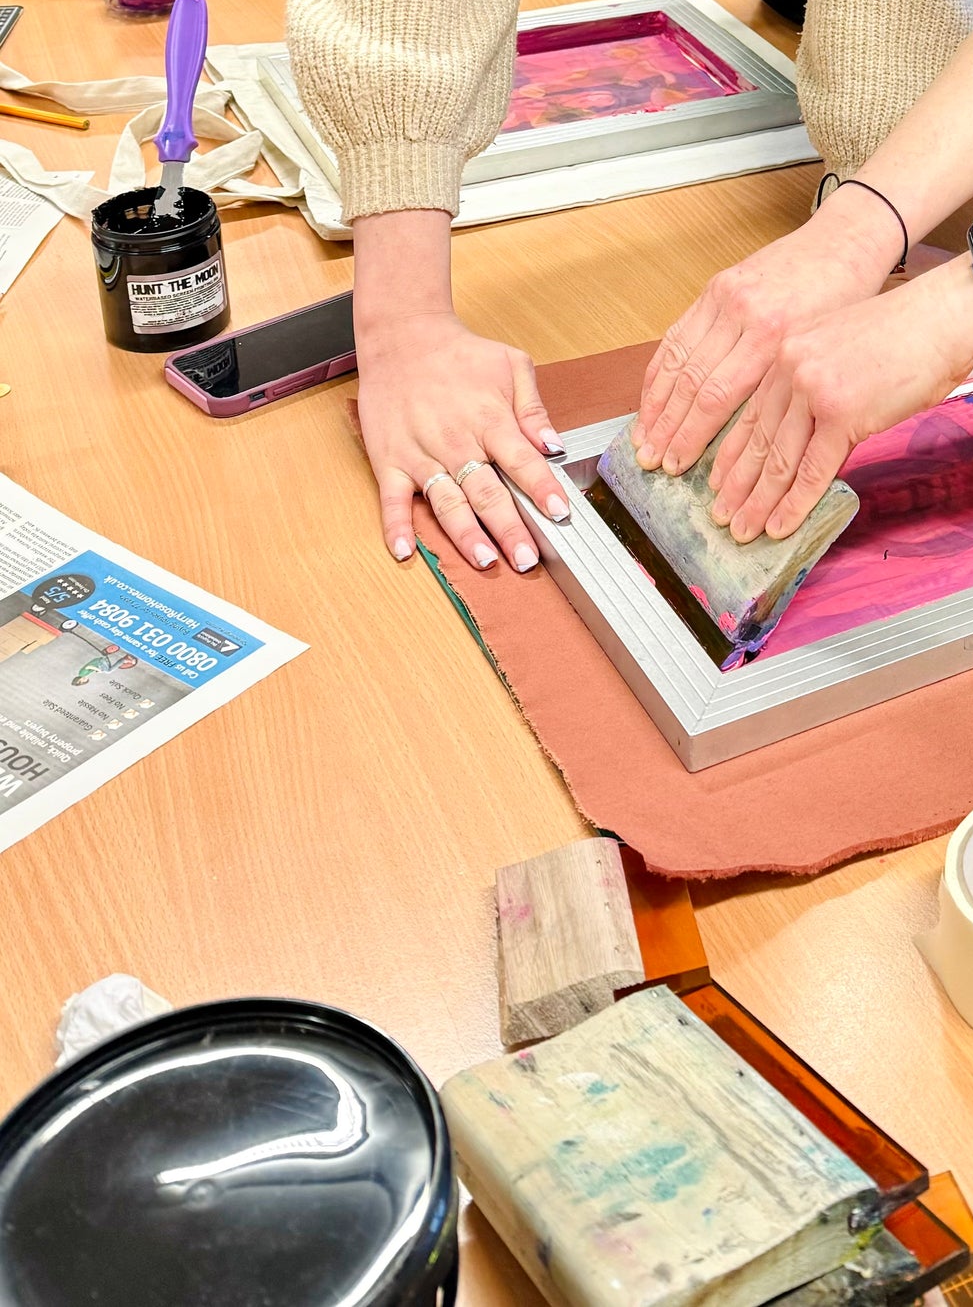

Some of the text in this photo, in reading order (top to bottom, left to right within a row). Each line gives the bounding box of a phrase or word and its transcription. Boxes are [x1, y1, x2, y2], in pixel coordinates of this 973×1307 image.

[131, 263, 219, 295] HUNT THE MOON
[103, 575, 200, 629] HarryRoseHomes.co.uk
[88, 599, 140, 627] 9084
[122, 635, 142, 650] same
[132, 621, 172, 646] 031
[144, 648, 158, 659] for
[155, 654, 176, 668] FREE
[166, 642, 218, 672] 0800
[175, 663, 185, 673] us
[185, 667, 199, 680] Call
[23, 719, 50, 737] buyers
[53, 707, 93, 731] Guaranteed
[18, 730, 48, 749] reliable
[48, 734, 83, 757] property
